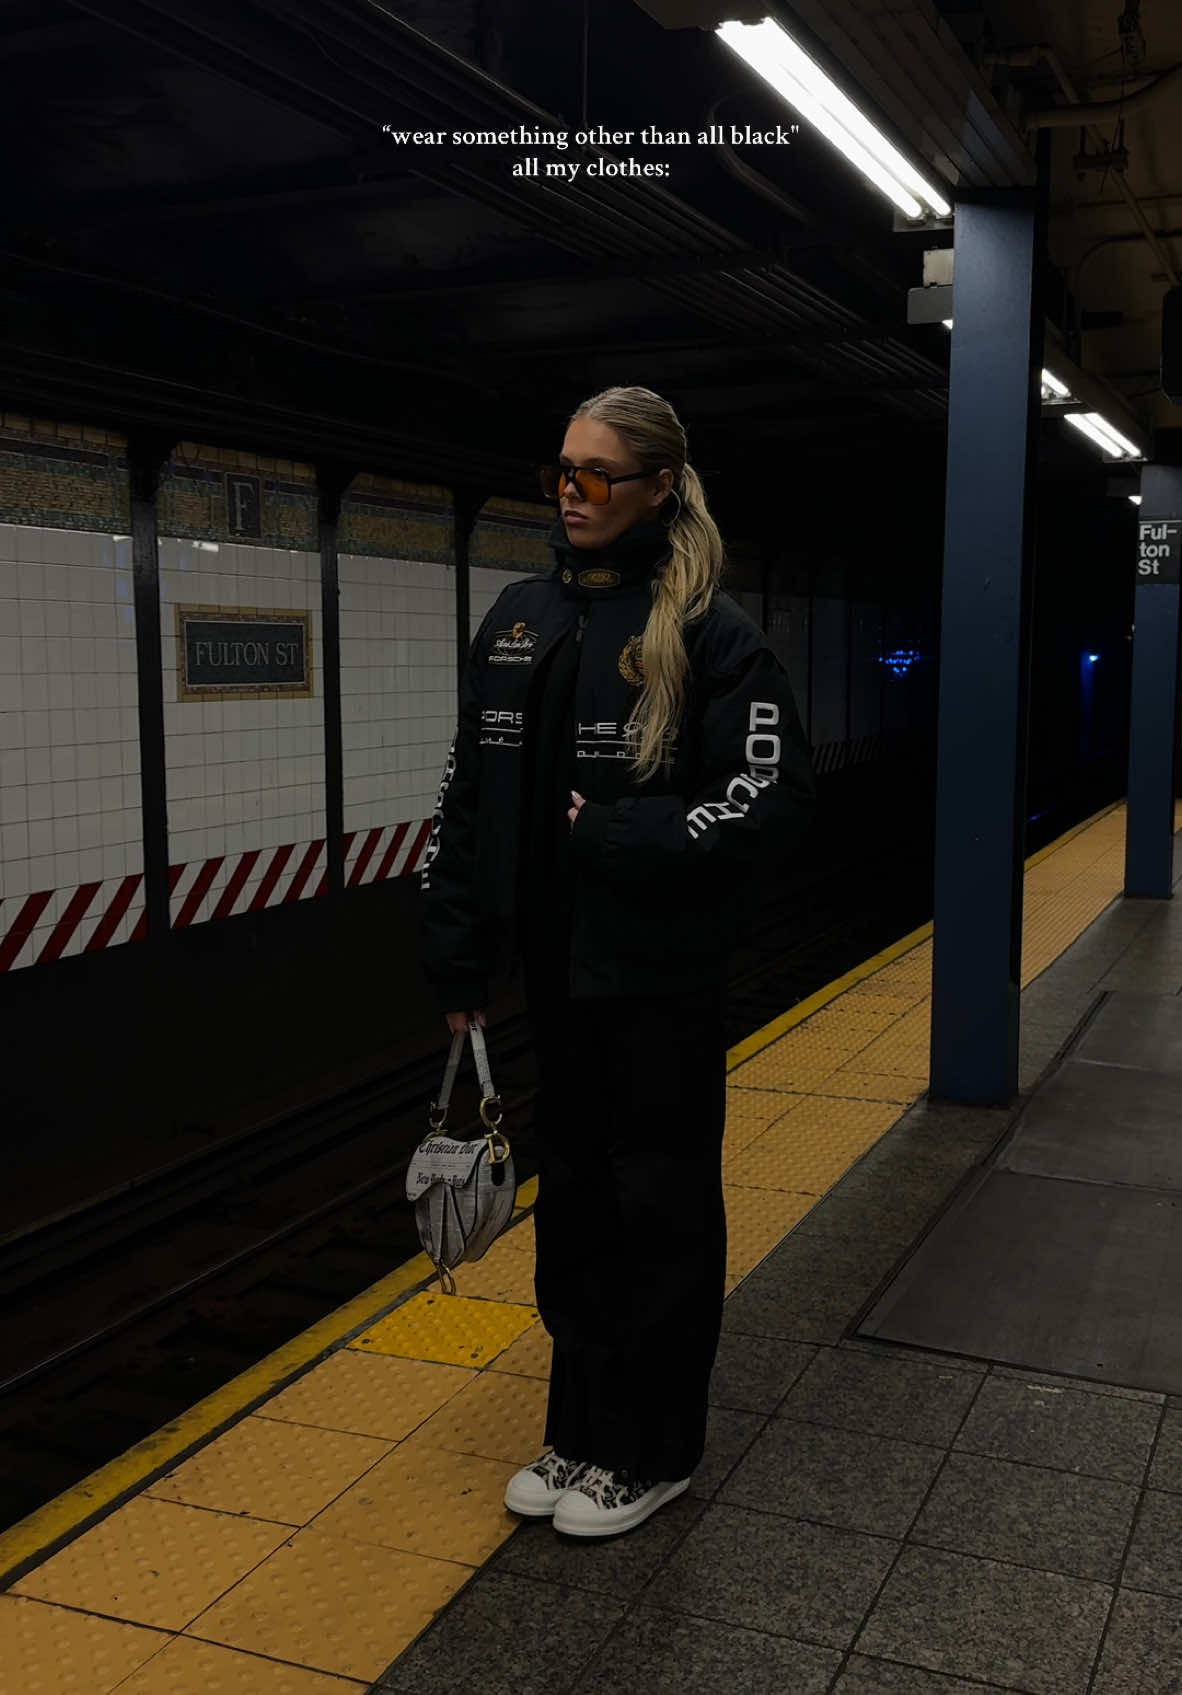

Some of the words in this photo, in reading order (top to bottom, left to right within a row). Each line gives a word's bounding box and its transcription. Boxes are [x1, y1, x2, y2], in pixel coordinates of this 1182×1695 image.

[232, 482, 256, 531] F
[1138, 523, 1178, 541] Ful-
[1139, 541, 1171, 558] ton
[1137, 559, 1160, 576] St
[193, 640, 270, 667] FULTON
[275, 641, 299, 666] ST
